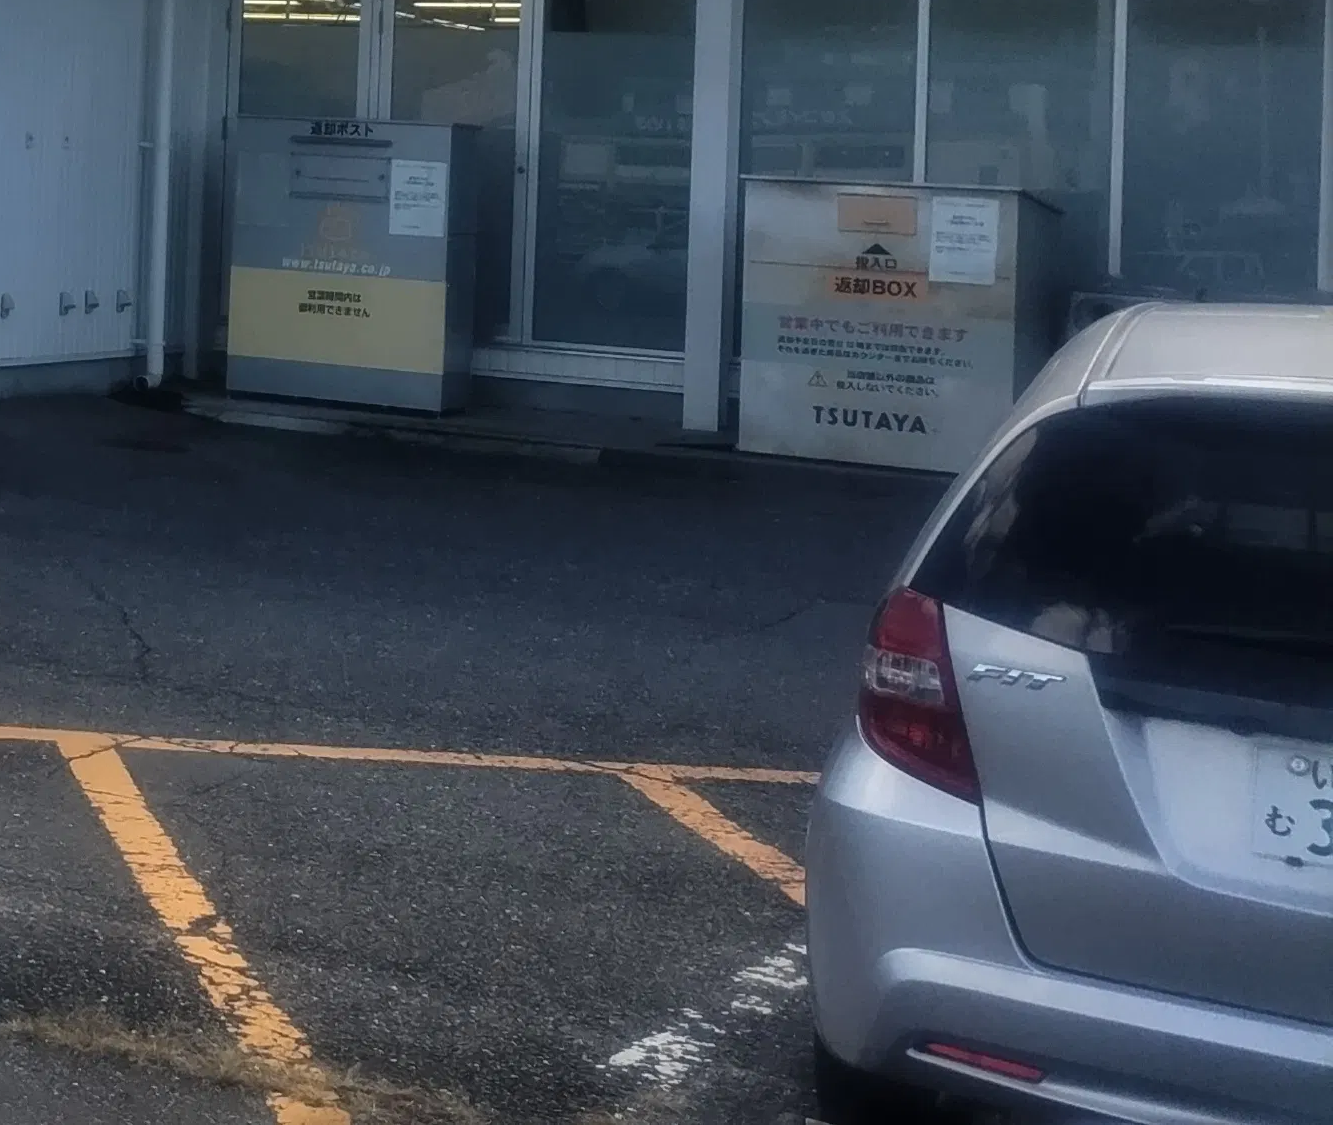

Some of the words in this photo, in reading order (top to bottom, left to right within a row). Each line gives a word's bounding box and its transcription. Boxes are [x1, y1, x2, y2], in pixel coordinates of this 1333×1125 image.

[282, 257, 391, 277] www.tsutaya.co.jp
[856, 255, 897, 271] 投入口
[834, 276, 918, 298] 返却BOX
[813, 405, 927, 434] TSUTAYA
[1265, 805, 1295, 836] む
